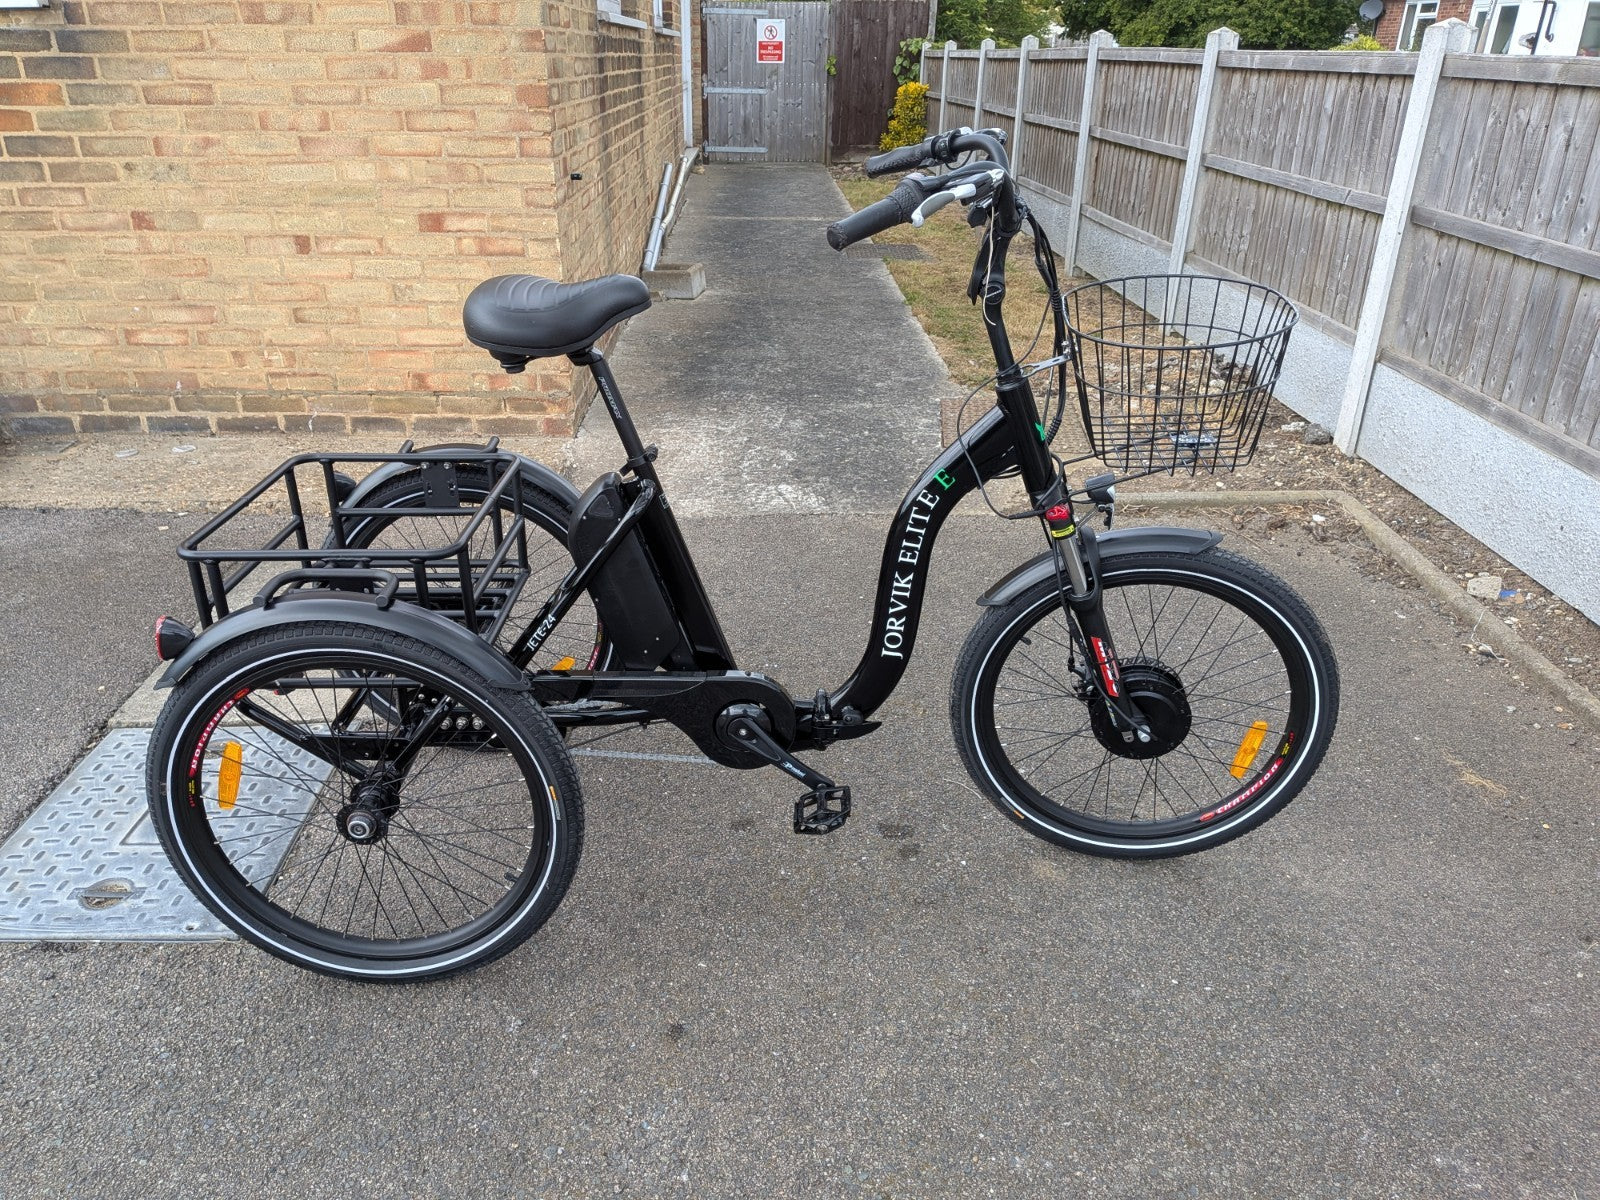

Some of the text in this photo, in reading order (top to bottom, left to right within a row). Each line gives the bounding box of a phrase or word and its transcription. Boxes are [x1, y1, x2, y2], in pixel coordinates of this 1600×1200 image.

[881, 468, 956, 660] JORVIK ELITE E
[526, 613, 556, 651] JETE-24
[190, 699, 235, 769] CHAMPION
[1216, 763, 1278, 814] CHAMPION
